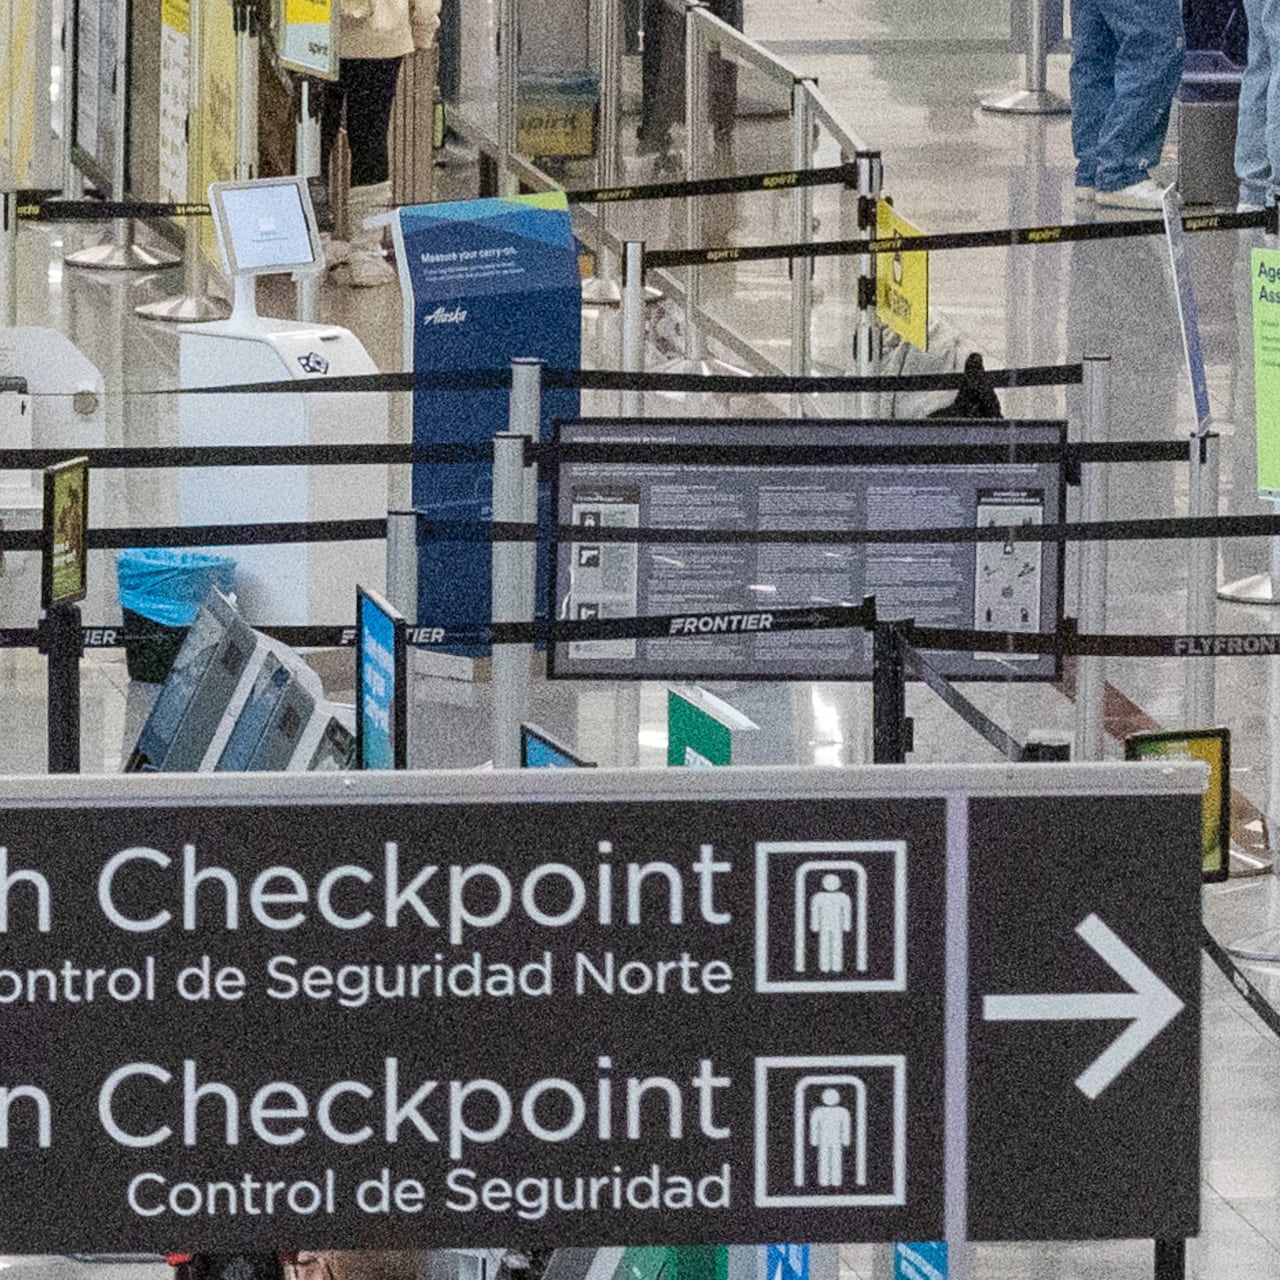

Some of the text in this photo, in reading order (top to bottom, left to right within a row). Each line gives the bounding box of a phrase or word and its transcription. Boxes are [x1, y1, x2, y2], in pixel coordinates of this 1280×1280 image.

[420, 252, 457, 264] Measure
[423, 305, 469, 326] Alaska
[669, 613, 773, 635] FRONTIER
[1173, 636, 1280, 654] FLYFRON
[98, 841, 732, 945] Checkpoint
[176, 955, 246, 1000] de
[266, 951, 554, 1008] Seguridad
[574, 950, 734, 997] Norte
[98, 1056, 732, 1160] Checkpoint
[126, 1163, 731, 1221] Control de Seguridad
